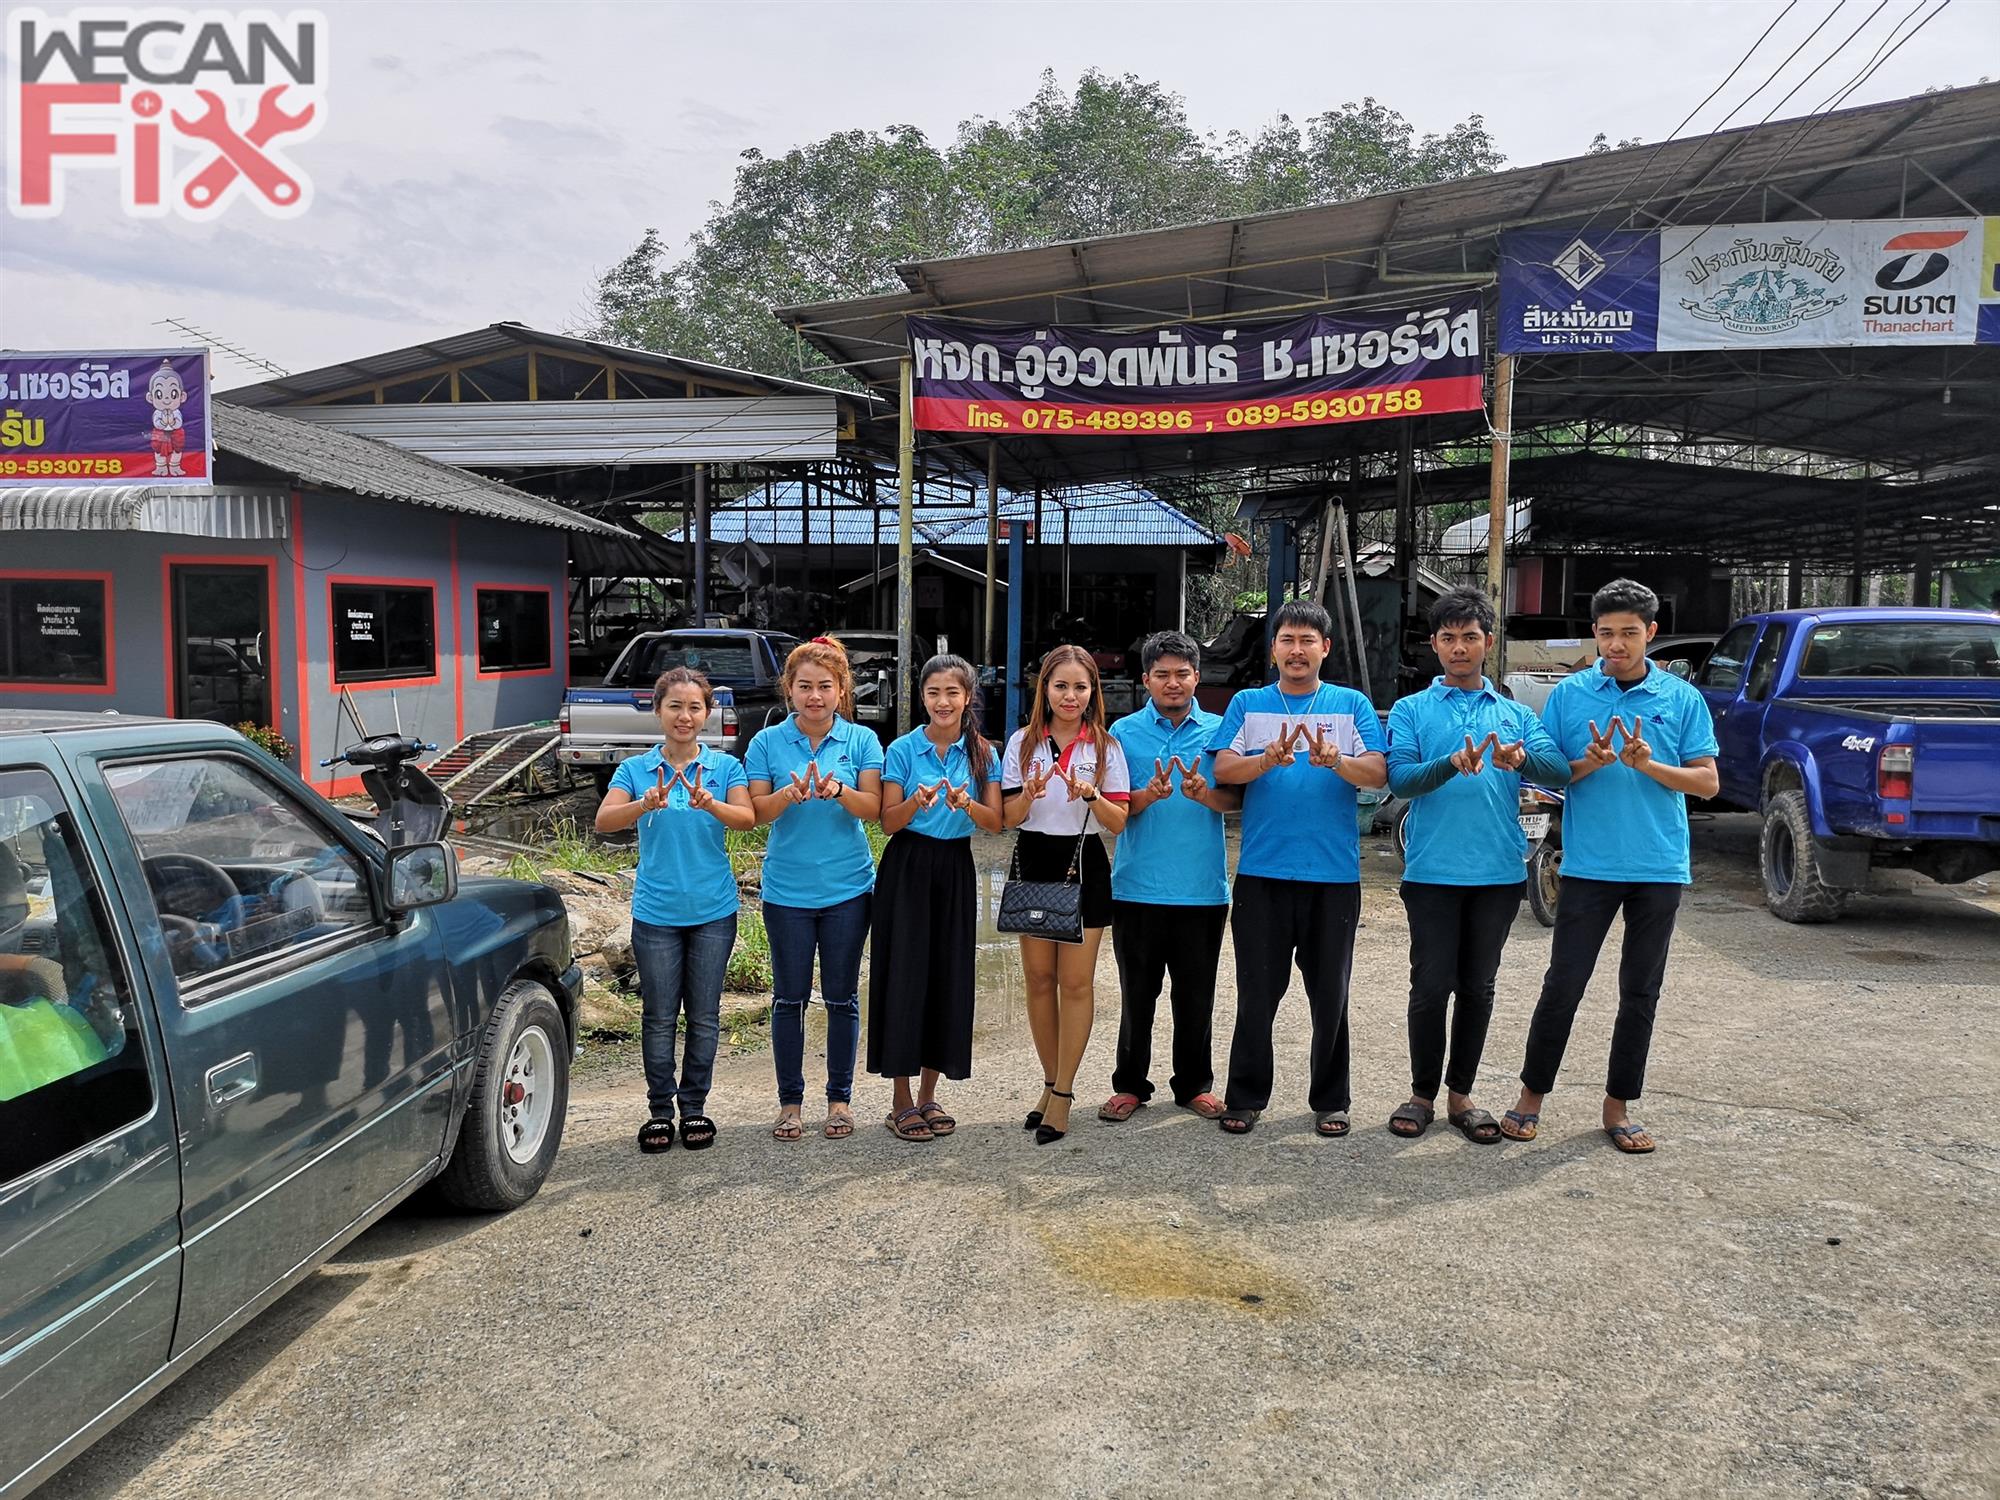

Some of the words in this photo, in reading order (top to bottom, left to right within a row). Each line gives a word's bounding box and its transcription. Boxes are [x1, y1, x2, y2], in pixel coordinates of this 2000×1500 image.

[1685, 236, 1846, 285] ประกันคุ้มภัย
[1864, 295, 1955, 315] ธนชาต
[1726, 321, 1754, 332] SAFETY
[1755, 320, 1796, 332] INSURANCE
[1863, 319, 1954, 333] Thanachart
[914, 330, 1238, 399] หจก.อู่อวดพันธ์
[1263, 308, 1479, 381] ช.เซอร์วิส
[967, 404, 1009, 428] โทร.
[1022, 408, 1192, 430] 075-489396
[1226, 388, 1423, 426] 089-5930758
